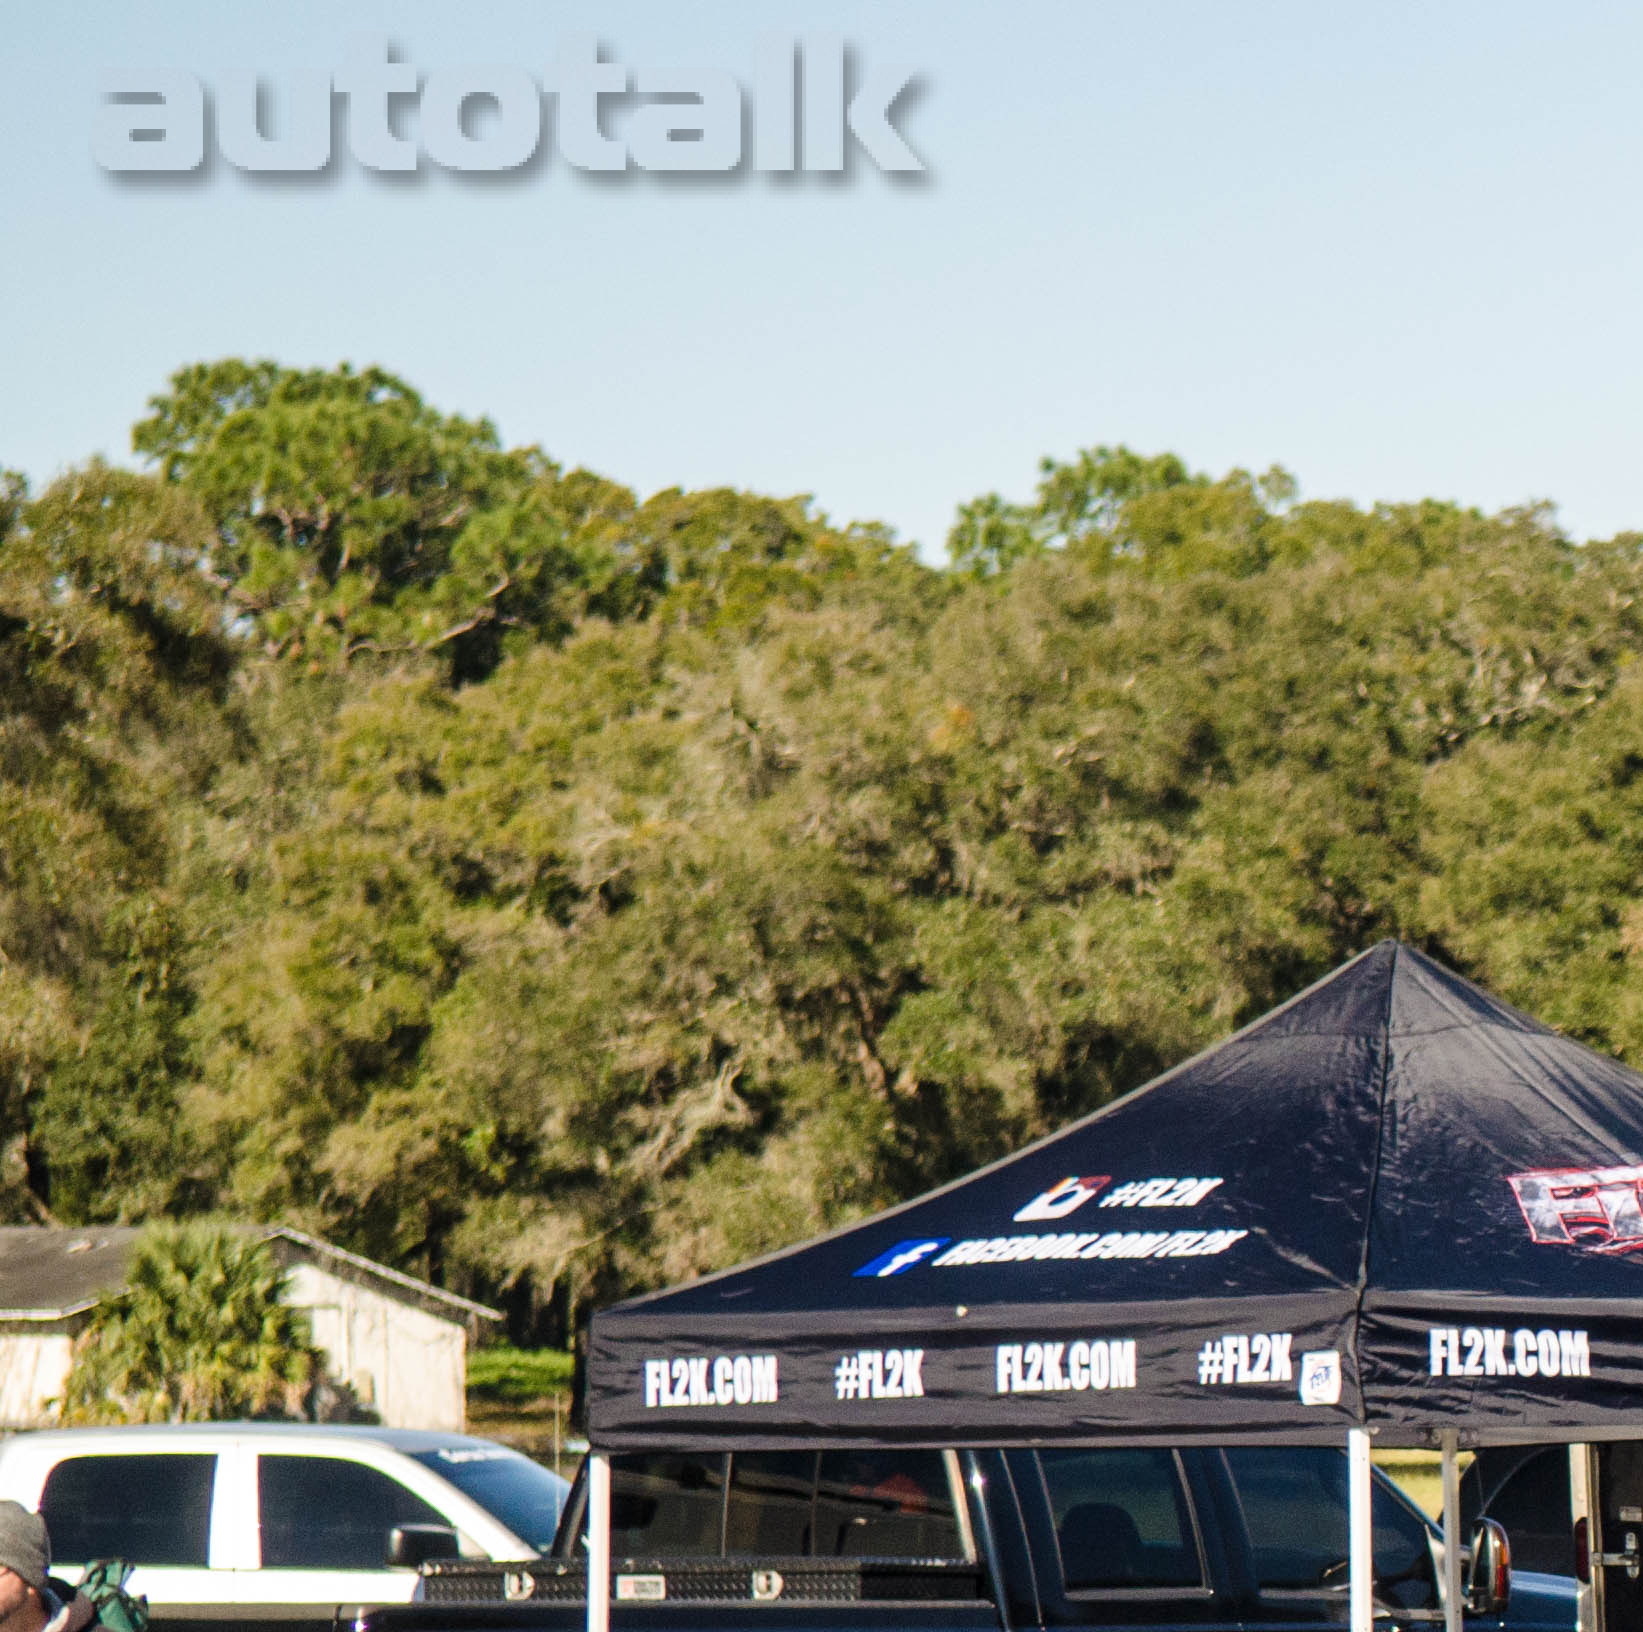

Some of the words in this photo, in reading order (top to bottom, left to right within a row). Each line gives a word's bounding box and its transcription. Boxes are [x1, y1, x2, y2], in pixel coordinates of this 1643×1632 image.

[1099, 1177, 1225, 1207] #FL2K
[644, 1355, 778, 1408] FL2K.COM
[835, 1348, 924, 1401] #FL2K
[996, 1339, 1137, 1394] FL2K.COM
[1199, 1332, 1293, 1385] #FL2K
[1429, 1328, 1591, 1378] FL2K.COM
